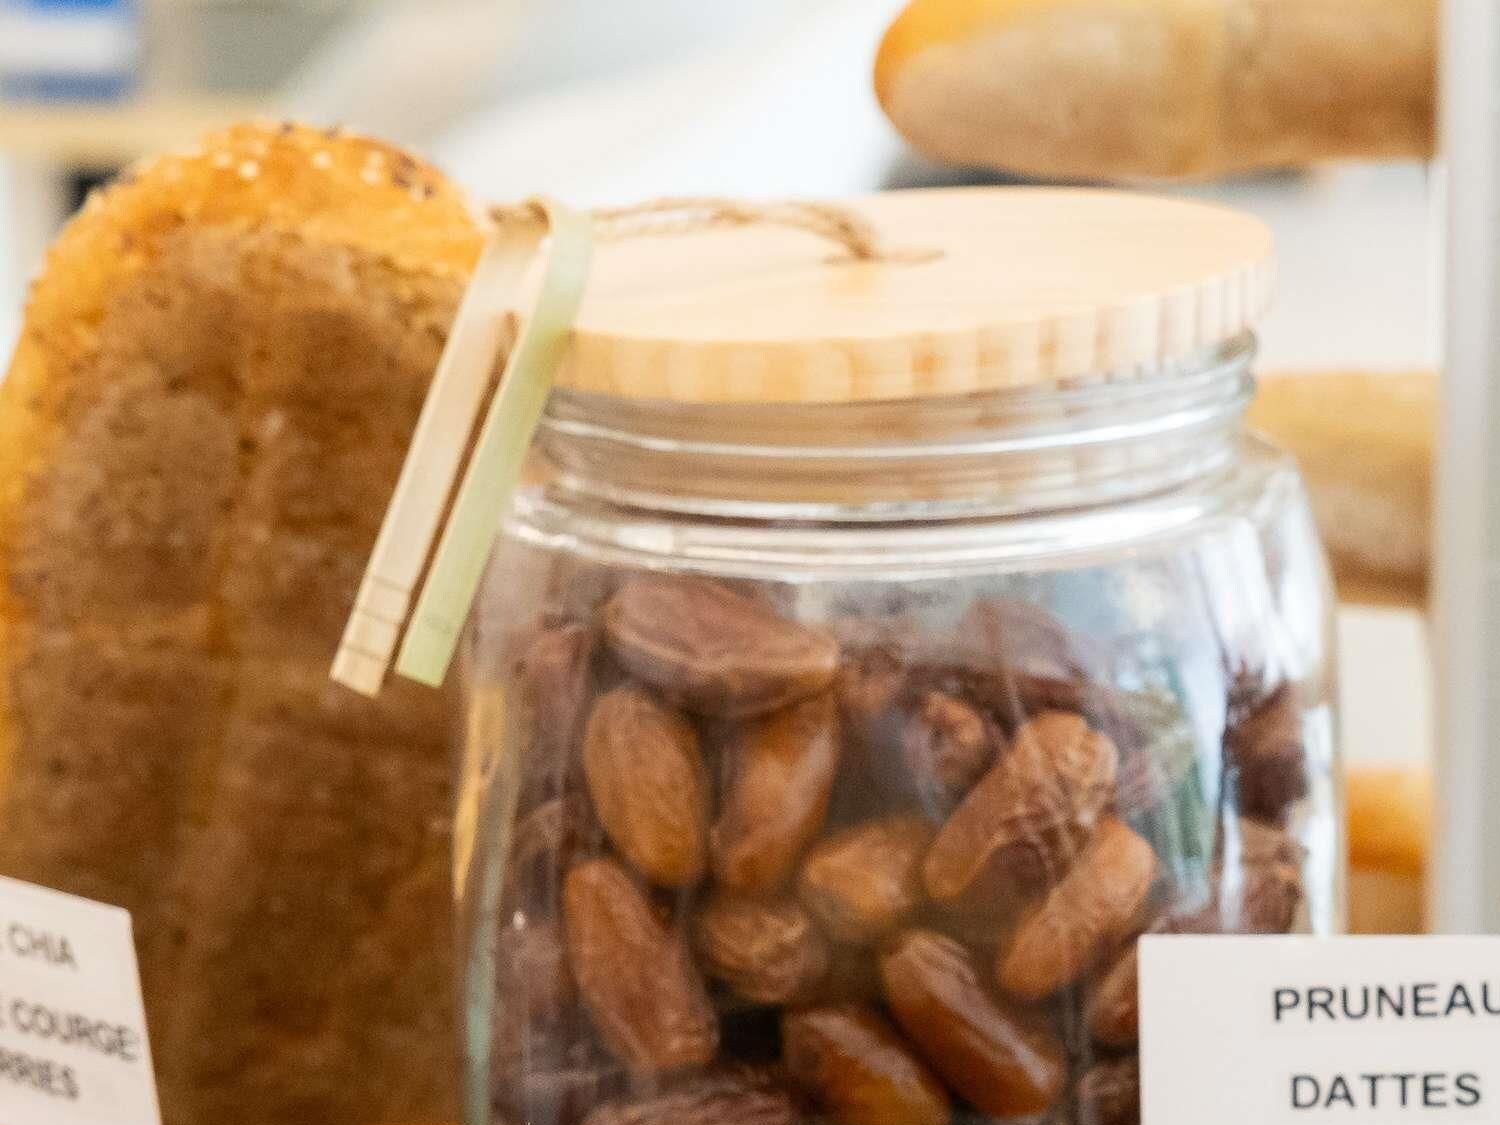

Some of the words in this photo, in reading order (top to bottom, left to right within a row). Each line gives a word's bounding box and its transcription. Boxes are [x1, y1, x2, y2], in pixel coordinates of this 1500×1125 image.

[8, 922, 78, 971] CHIA
[10, 998, 138, 1062] COURGE
[1291, 1073, 1481, 1108] DATTES
